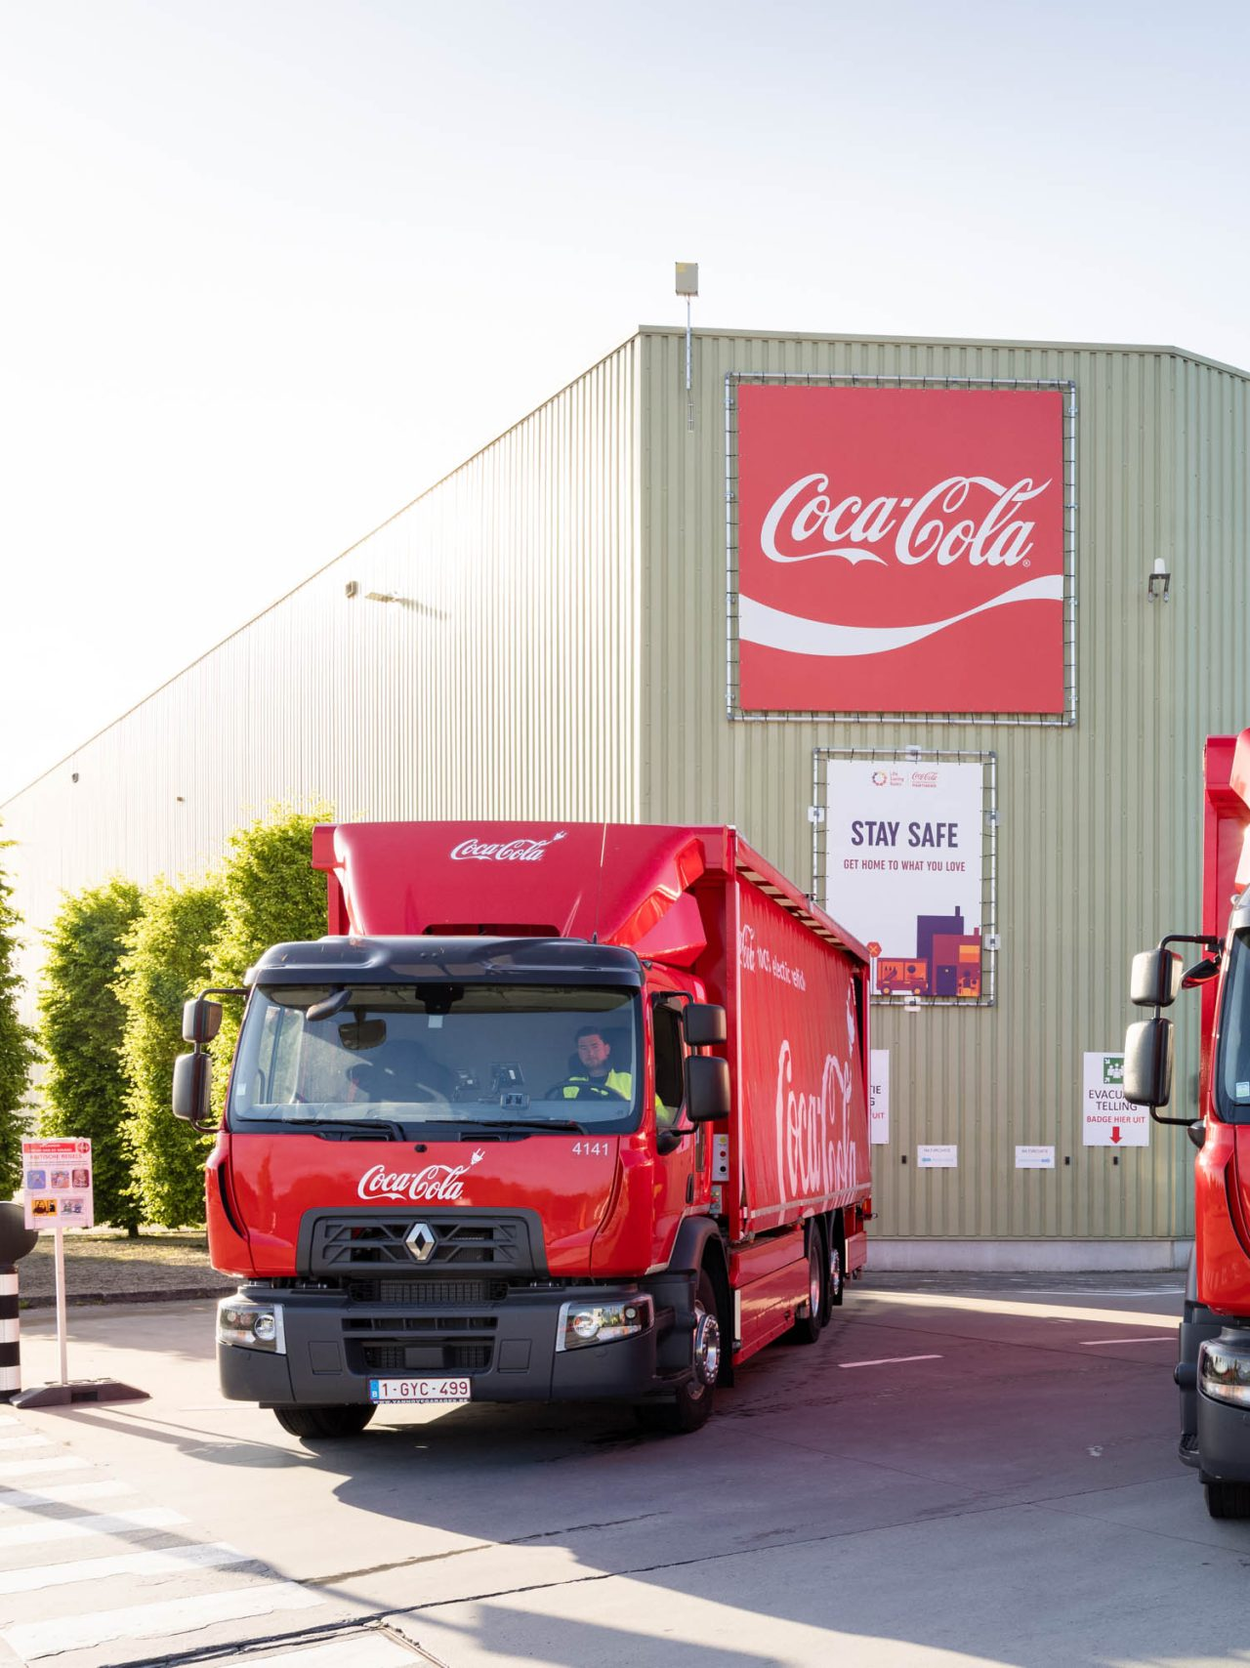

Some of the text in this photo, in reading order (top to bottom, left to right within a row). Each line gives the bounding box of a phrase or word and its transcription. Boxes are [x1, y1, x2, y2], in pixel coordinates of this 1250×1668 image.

[760, 473, 1052, 567] Coca-Cola
[851, 820, 958, 848] STAY SAFE
[450, 839, 553, 861] Coca-Cola
[843, 859, 966, 872] GET HOME TO WHAT YOU LOVE
[1088, 1090, 1126, 1099] EVACU
[1096, 1101, 1138, 1111] TELLING
[572, 1142, 609, 1156] 4141
[357, 1164, 471, 1201] Coca-Cola
[382, 1382, 468, 1396] 1-GYC-499
